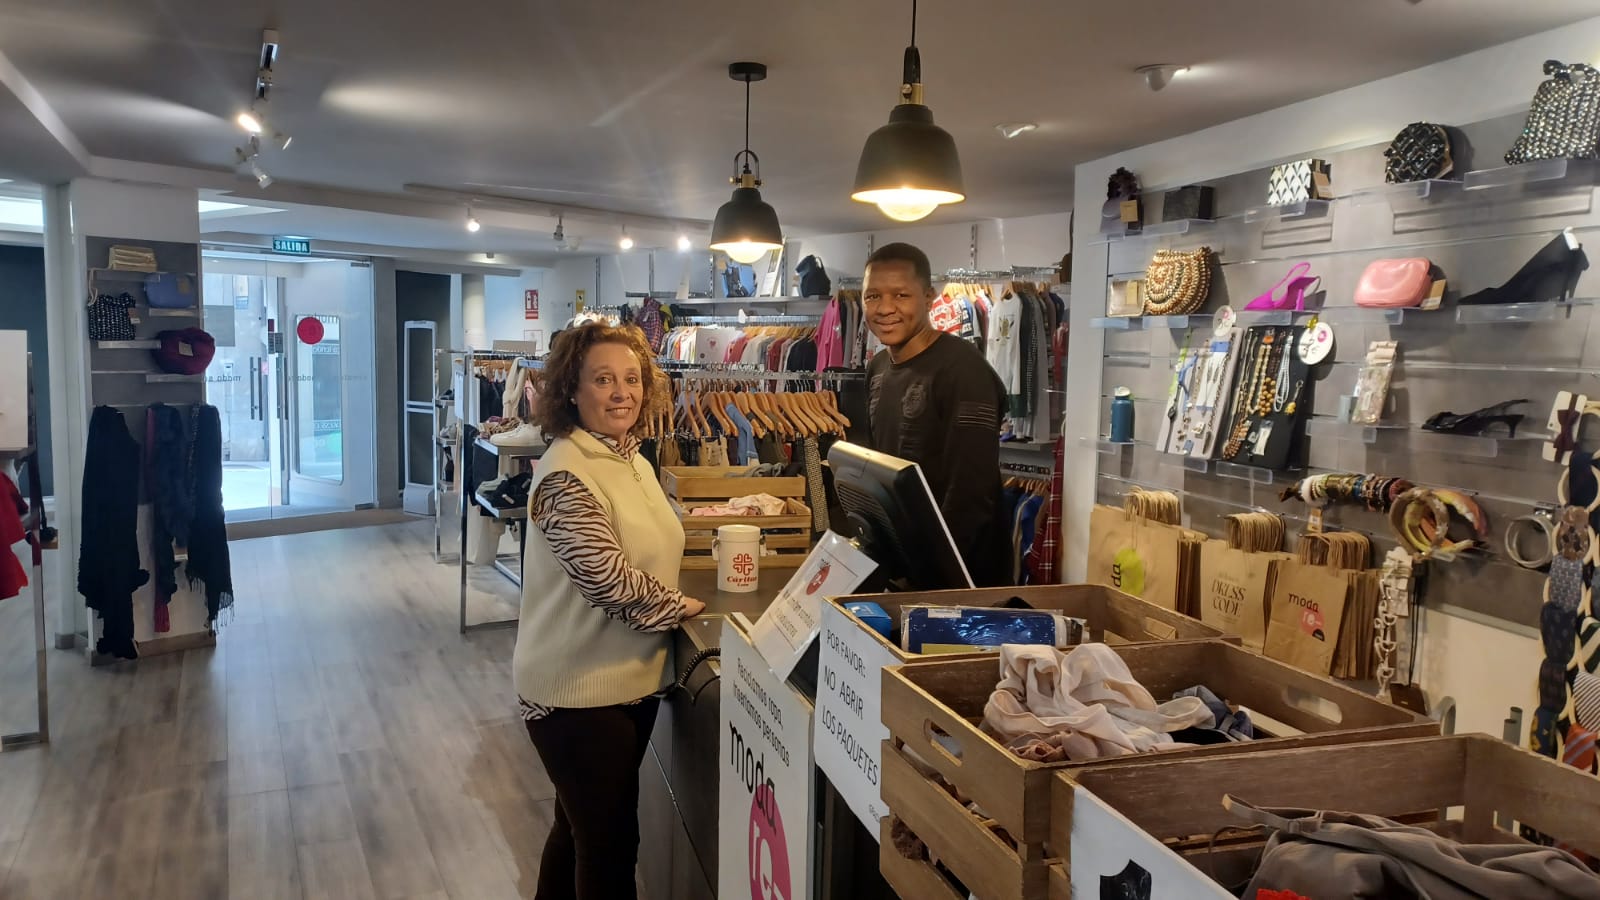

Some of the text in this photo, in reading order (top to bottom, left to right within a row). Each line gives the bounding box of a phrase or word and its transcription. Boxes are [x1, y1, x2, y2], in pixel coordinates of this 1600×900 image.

[275, 240, 308, 252] SALIDA
[1110, 563, 1122, 588] da
[1211, 579, 1246, 601] DRESS
[1212, 598, 1242, 618] CODE
[1288, 592, 1319, 614] moda
[826, 629, 866, 678] POR FAVOR:
[824, 665, 864, 720] NO ABRIR
[822, 705, 836, 735] LOS
[836, 720, 879, 787] PAQUETES
[729, 720, 777, 836] moda
